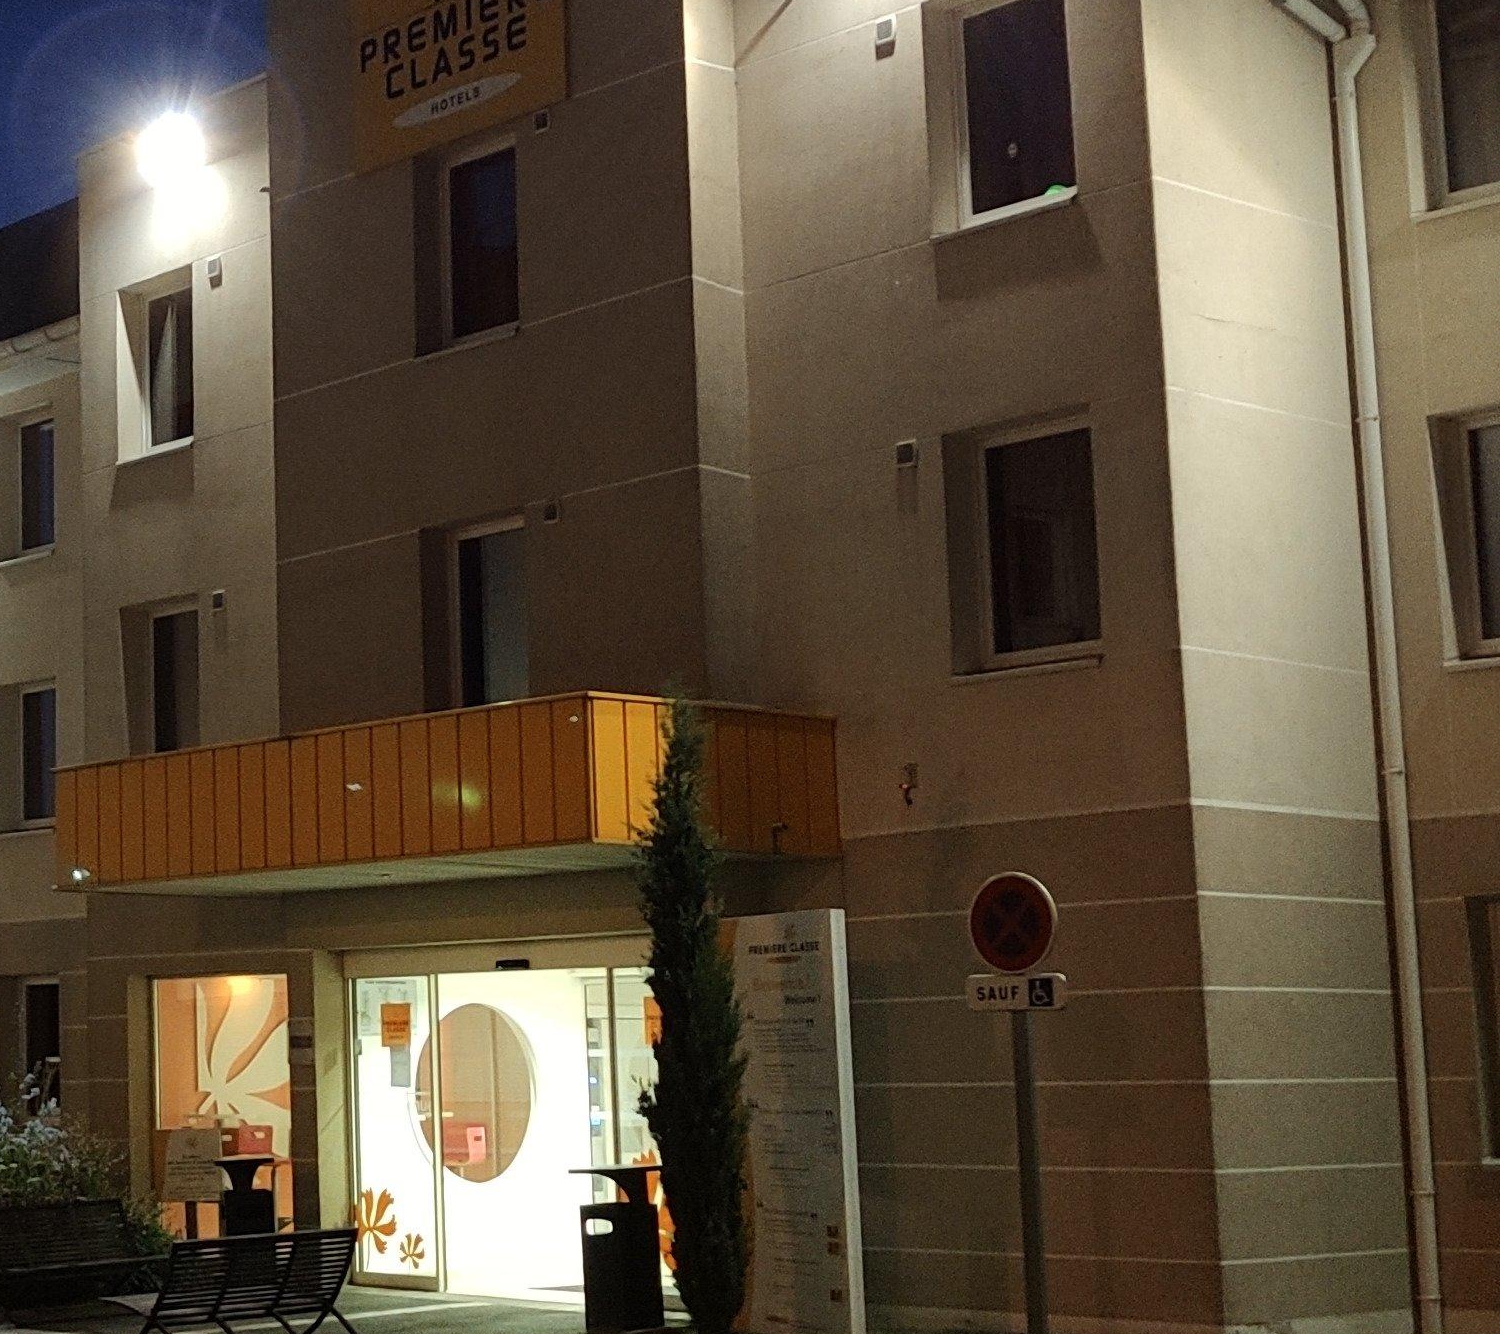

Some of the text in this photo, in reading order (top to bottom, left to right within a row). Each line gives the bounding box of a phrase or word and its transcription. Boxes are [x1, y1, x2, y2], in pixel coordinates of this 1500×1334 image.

[385, 14, 527, 100] CLASSE
[430, 86, 481, 115] HOTELS
[976, 985, 1019, 1002] SAUF
